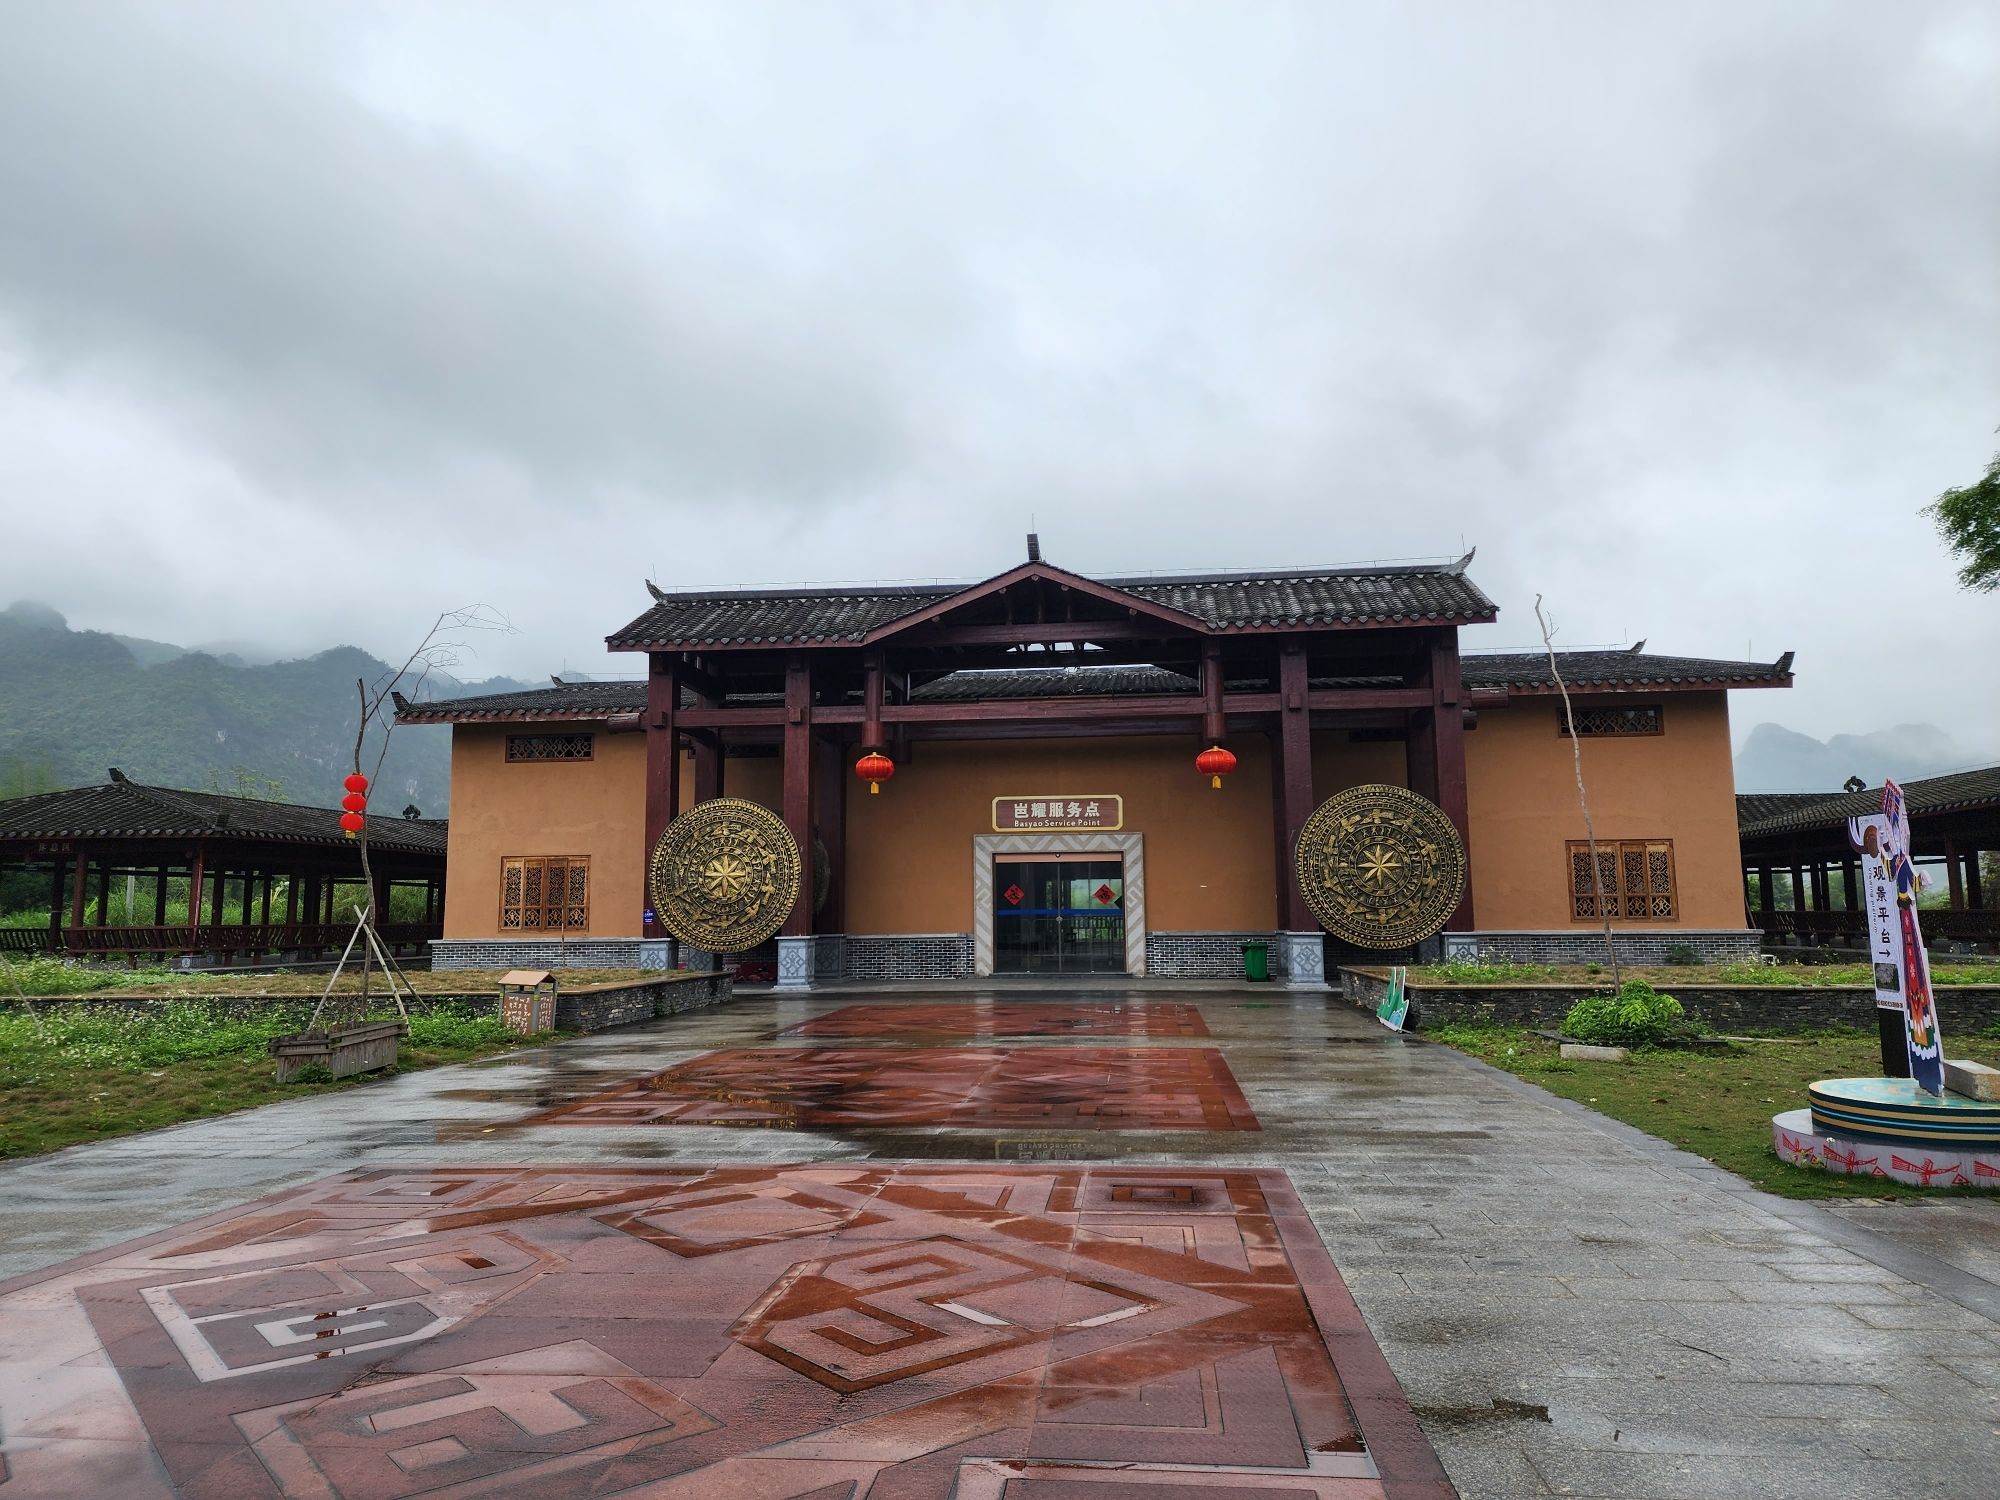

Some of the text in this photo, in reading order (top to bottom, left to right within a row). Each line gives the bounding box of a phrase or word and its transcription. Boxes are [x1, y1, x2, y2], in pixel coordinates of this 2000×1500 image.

[1014, 801, 1100, 819] 岜耀服务点
[1014, 819, 1101, 828] Basyao Service Point
[1873, 866, 1891, 944] 观景平台
